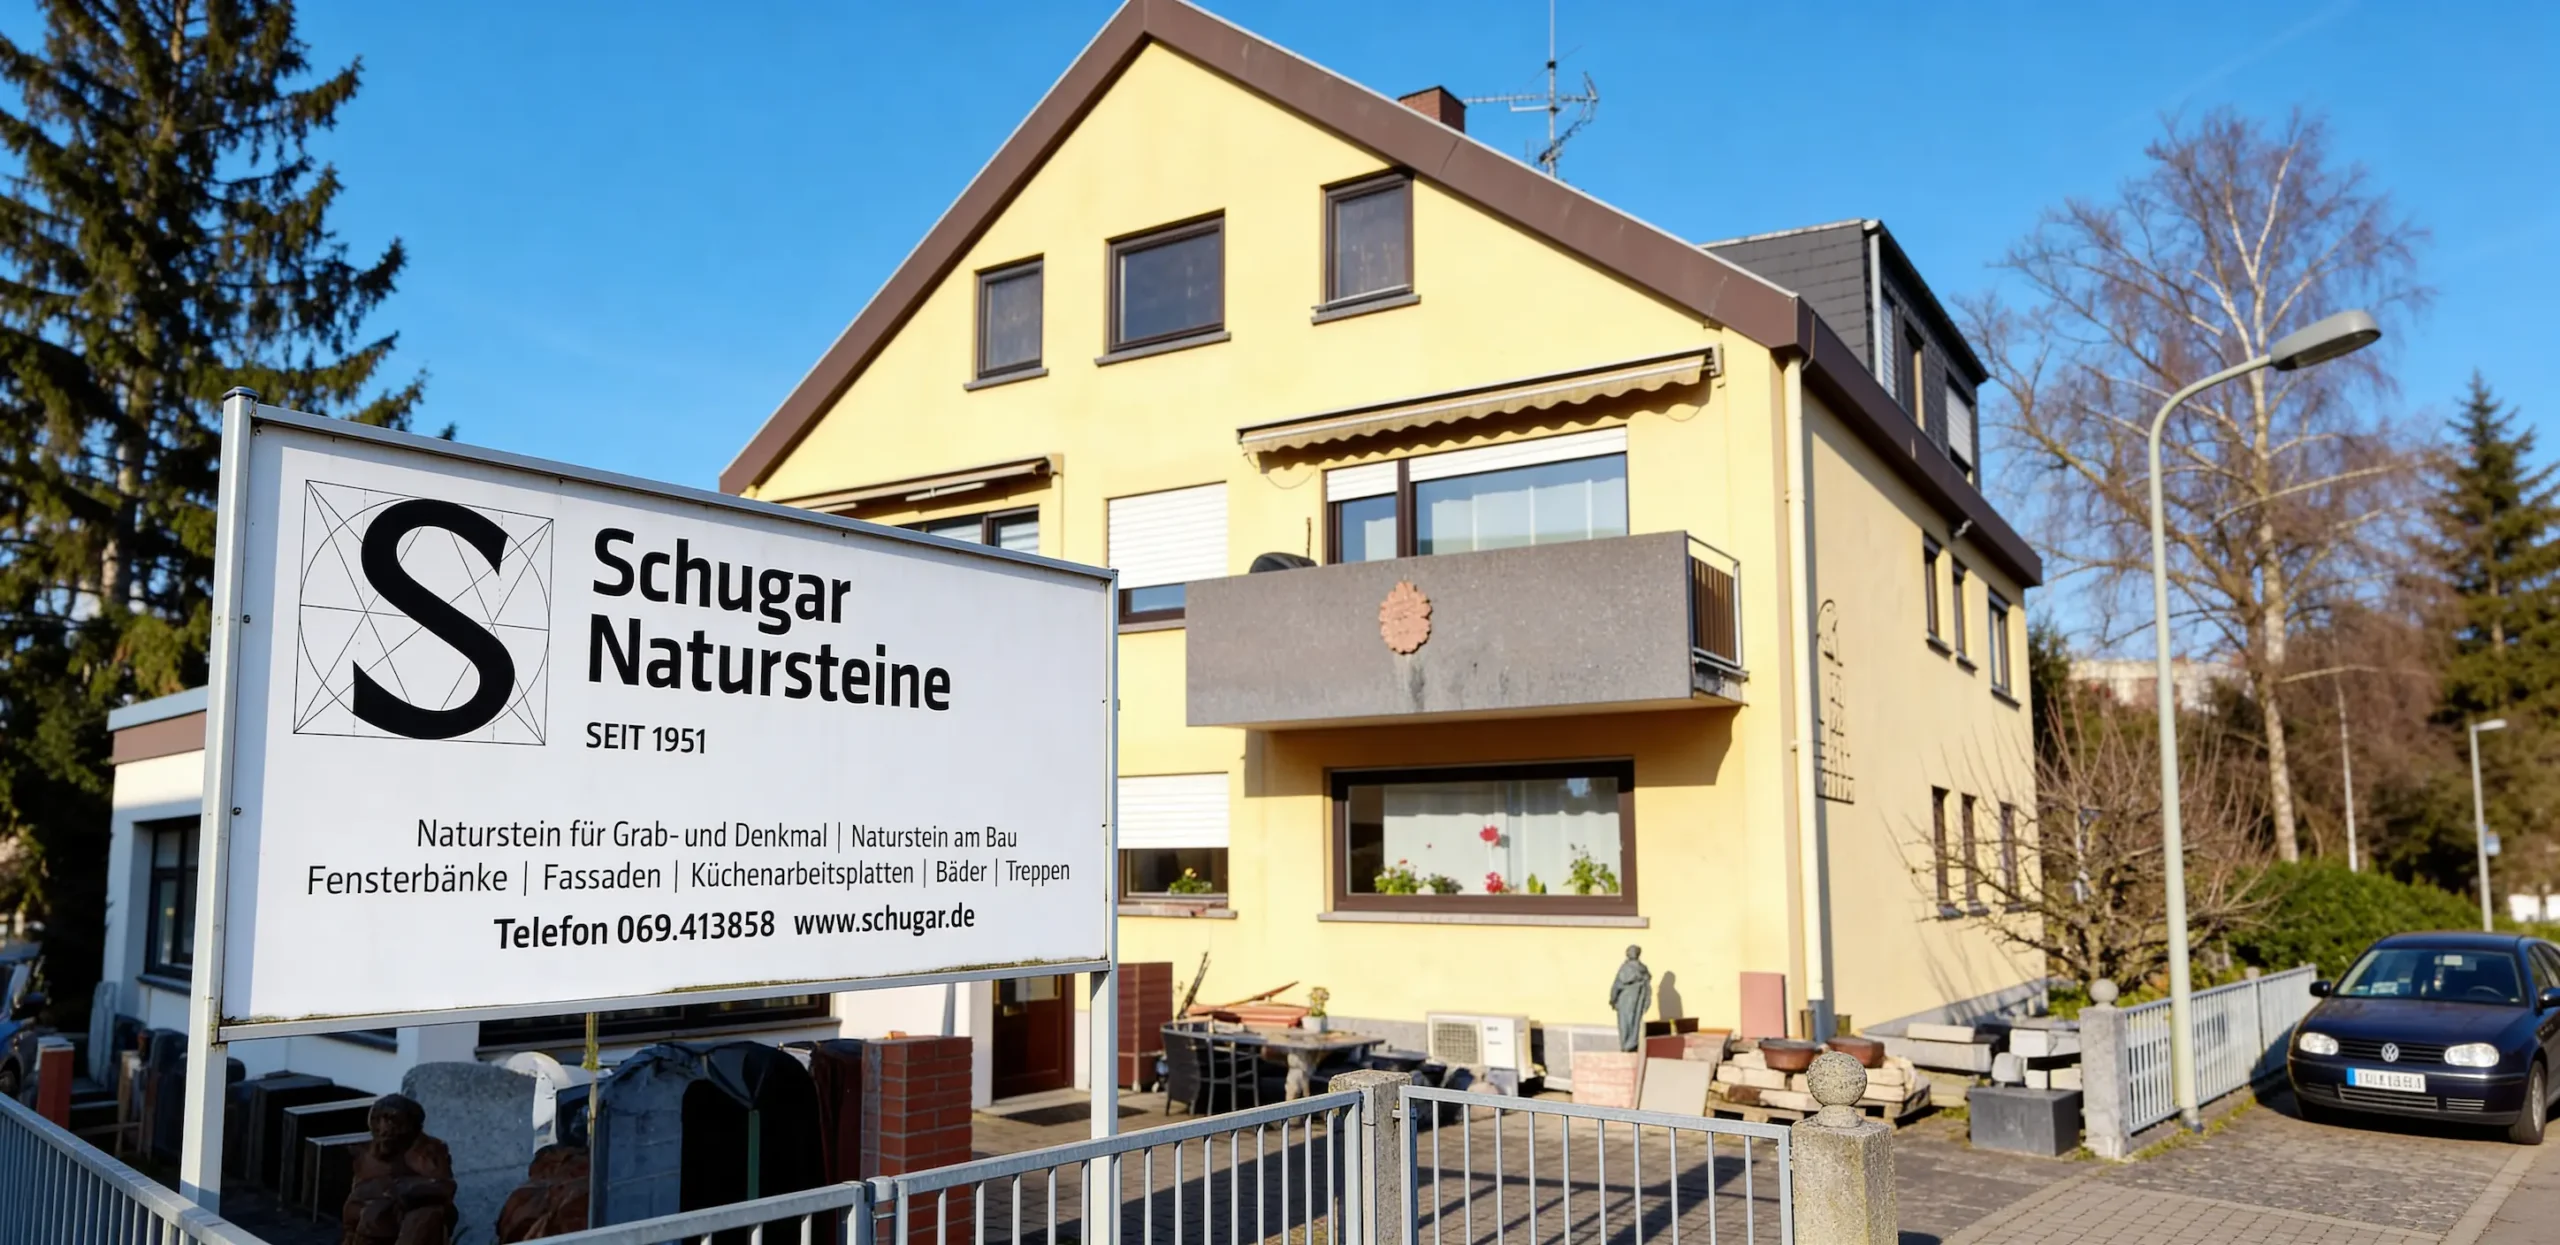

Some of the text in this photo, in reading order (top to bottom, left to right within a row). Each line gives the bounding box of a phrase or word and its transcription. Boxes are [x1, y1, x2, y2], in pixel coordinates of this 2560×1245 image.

[592, 527, 853, 637] Schugar
[352, 498, 516, 741] S
[588, 613, 952, 712] Natursteine
[586, 721, 707, 755] SEIT 1951
[417, 818, 1018, 849] Naturstein für Grab- und Denkmal Naturstein am Bau
[307, 859, 1071, 895] Fensterbänke Fassaden Küchenarbeitsplatten Bäder Treppen
[493, 902, 975, 950] Telefon 069.413858 www.schugar.de
